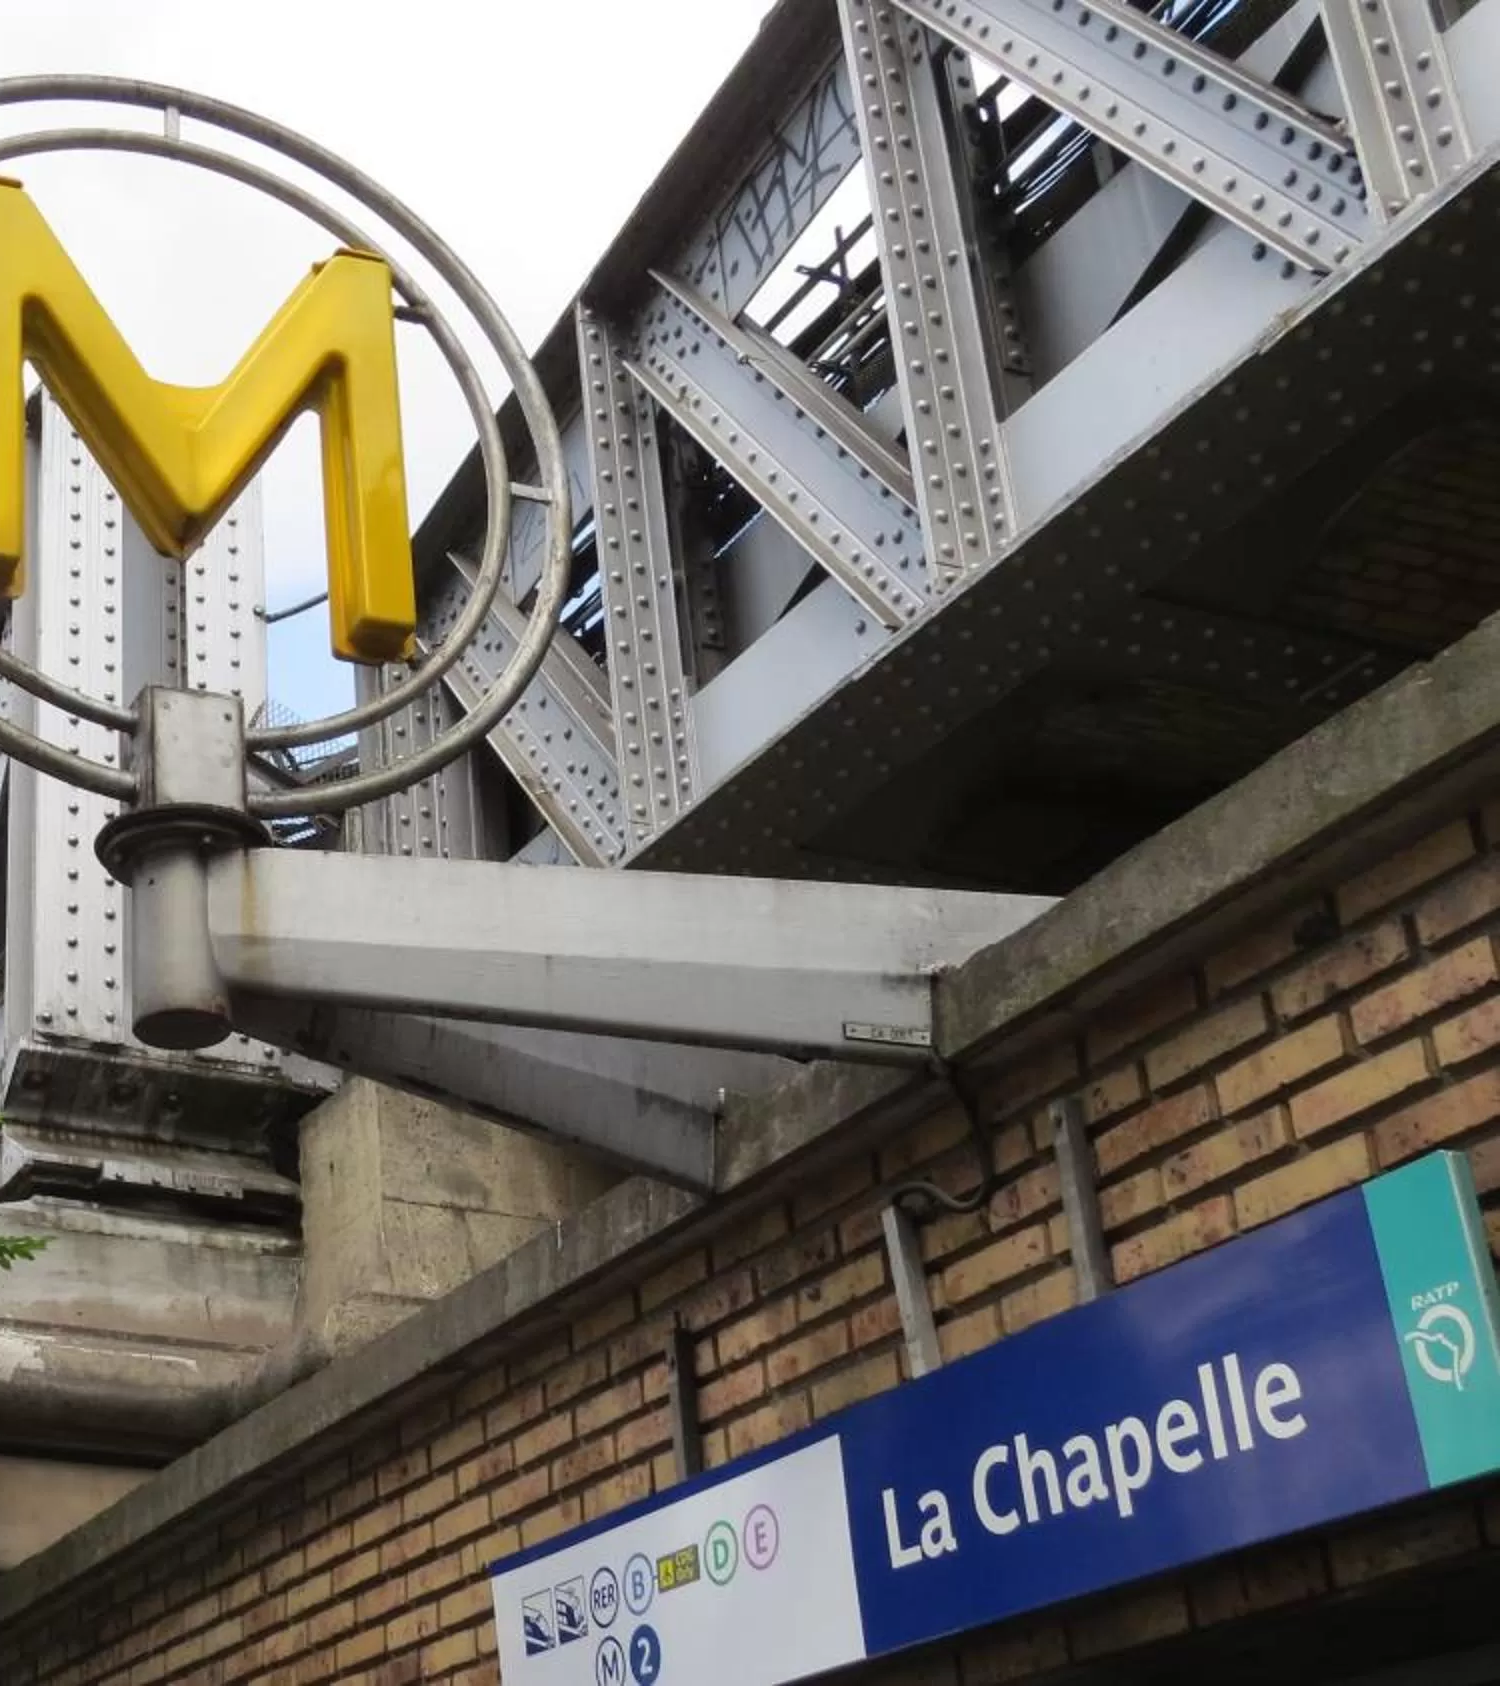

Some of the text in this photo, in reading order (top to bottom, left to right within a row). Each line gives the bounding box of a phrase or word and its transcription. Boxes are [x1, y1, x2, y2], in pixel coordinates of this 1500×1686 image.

[1411, 1281, 1459, 1312] RATP
[882, 1353, 1307, 1569] La Chapelle
[593, 1582, 615, 1609] RER
